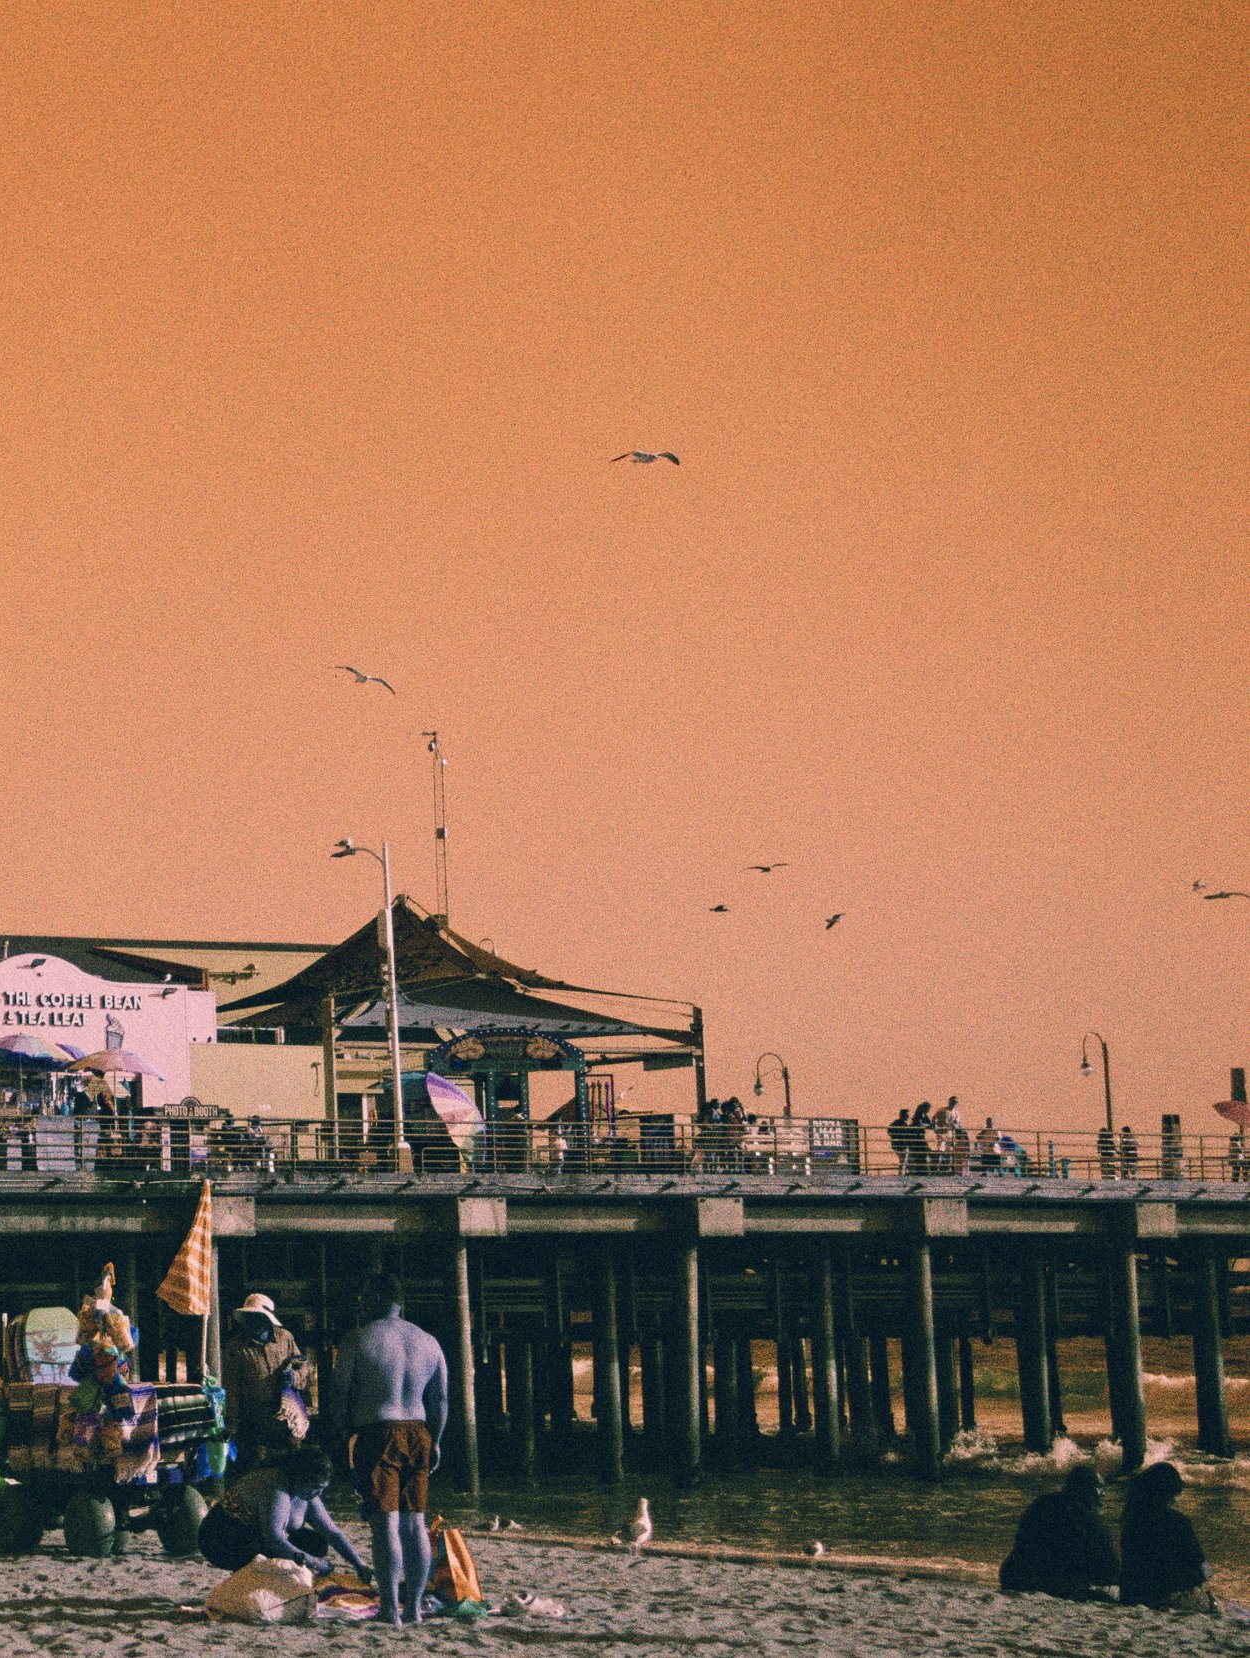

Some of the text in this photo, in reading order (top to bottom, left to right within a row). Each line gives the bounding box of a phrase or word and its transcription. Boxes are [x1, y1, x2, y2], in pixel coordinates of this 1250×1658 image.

[3, 991, 142, 1010] THE COFFEE BEAN
[16, 1010, 46, 1026] TEA
[49, 1011, 88, 1027] LEAF
[164, 1105, 218, 1117] PHOTO BOOTH
